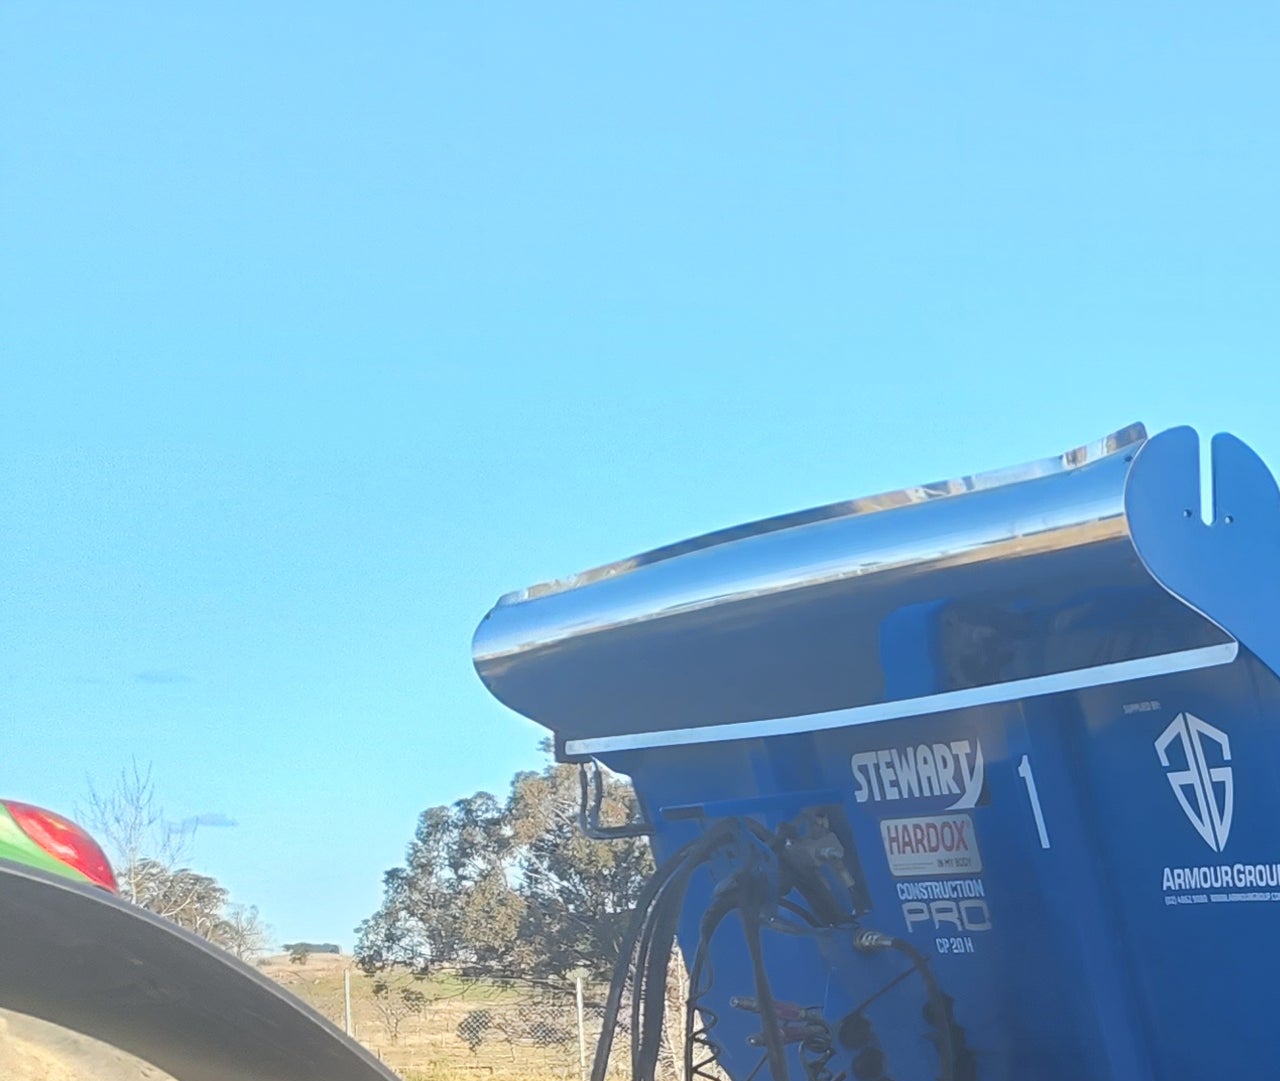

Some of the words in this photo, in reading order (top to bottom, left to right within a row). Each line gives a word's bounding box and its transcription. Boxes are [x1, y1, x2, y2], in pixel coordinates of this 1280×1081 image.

[851, 738, 984, 811] STEWART
[1018, 755, 1050, 849] 1
[886, 820, 969, 855] HARDOX
[896, 879, 985, 901] CONSTRUCTION
[902, 900, 992, 933] PRO
[936, 938, 949, 953] CP
[950, 937, 965, 953] 20
